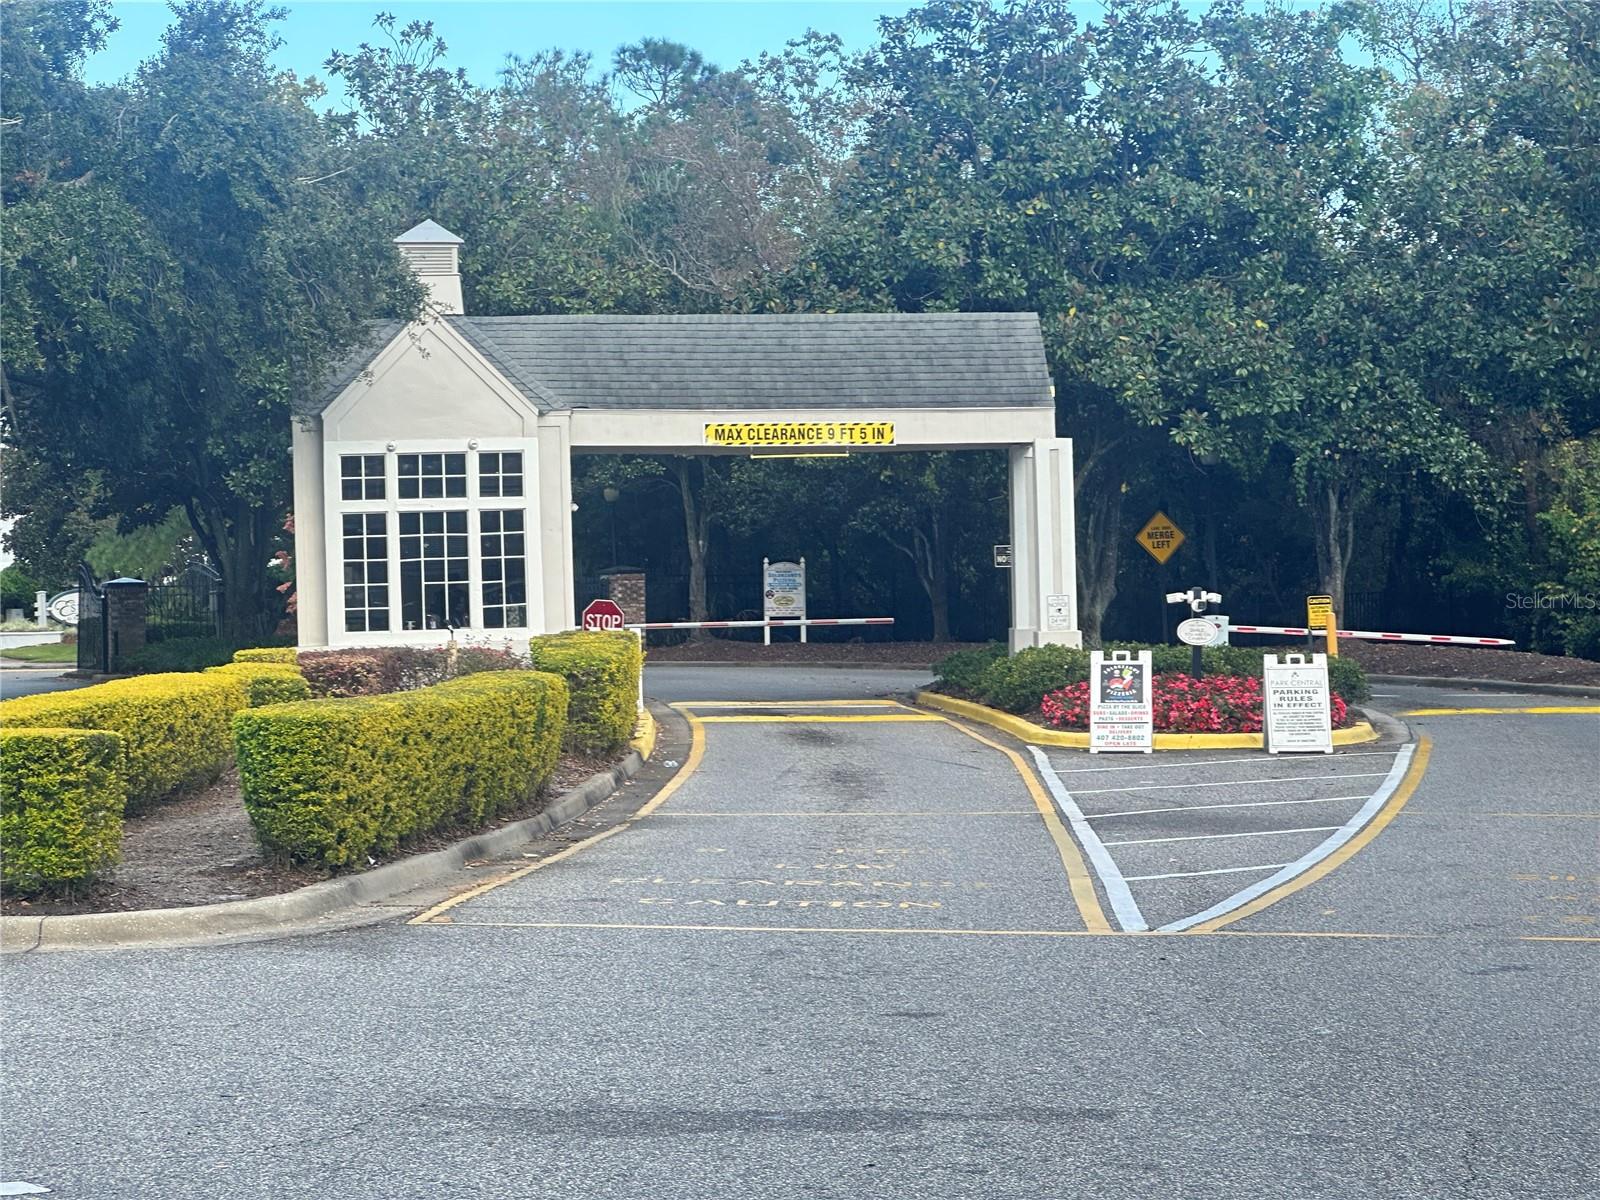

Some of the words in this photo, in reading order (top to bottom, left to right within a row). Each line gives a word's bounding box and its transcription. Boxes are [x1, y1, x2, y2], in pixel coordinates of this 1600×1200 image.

[714, 428, 743, 441] MAX
[747, 427, 823, 441] CLEARANCE
[827, 427, 836, 440] 9
[840, 427, 856, 440] FT
[859, 427, 867, 440] 5
[872, 427, 885, 440] IN
[1147, 530, 1175, 539] MERGE
[1152, 540, 1171, 549] LEFT
[585, 613, 621, 630] STOP
[637, 897, 943, 909] CAUTION
